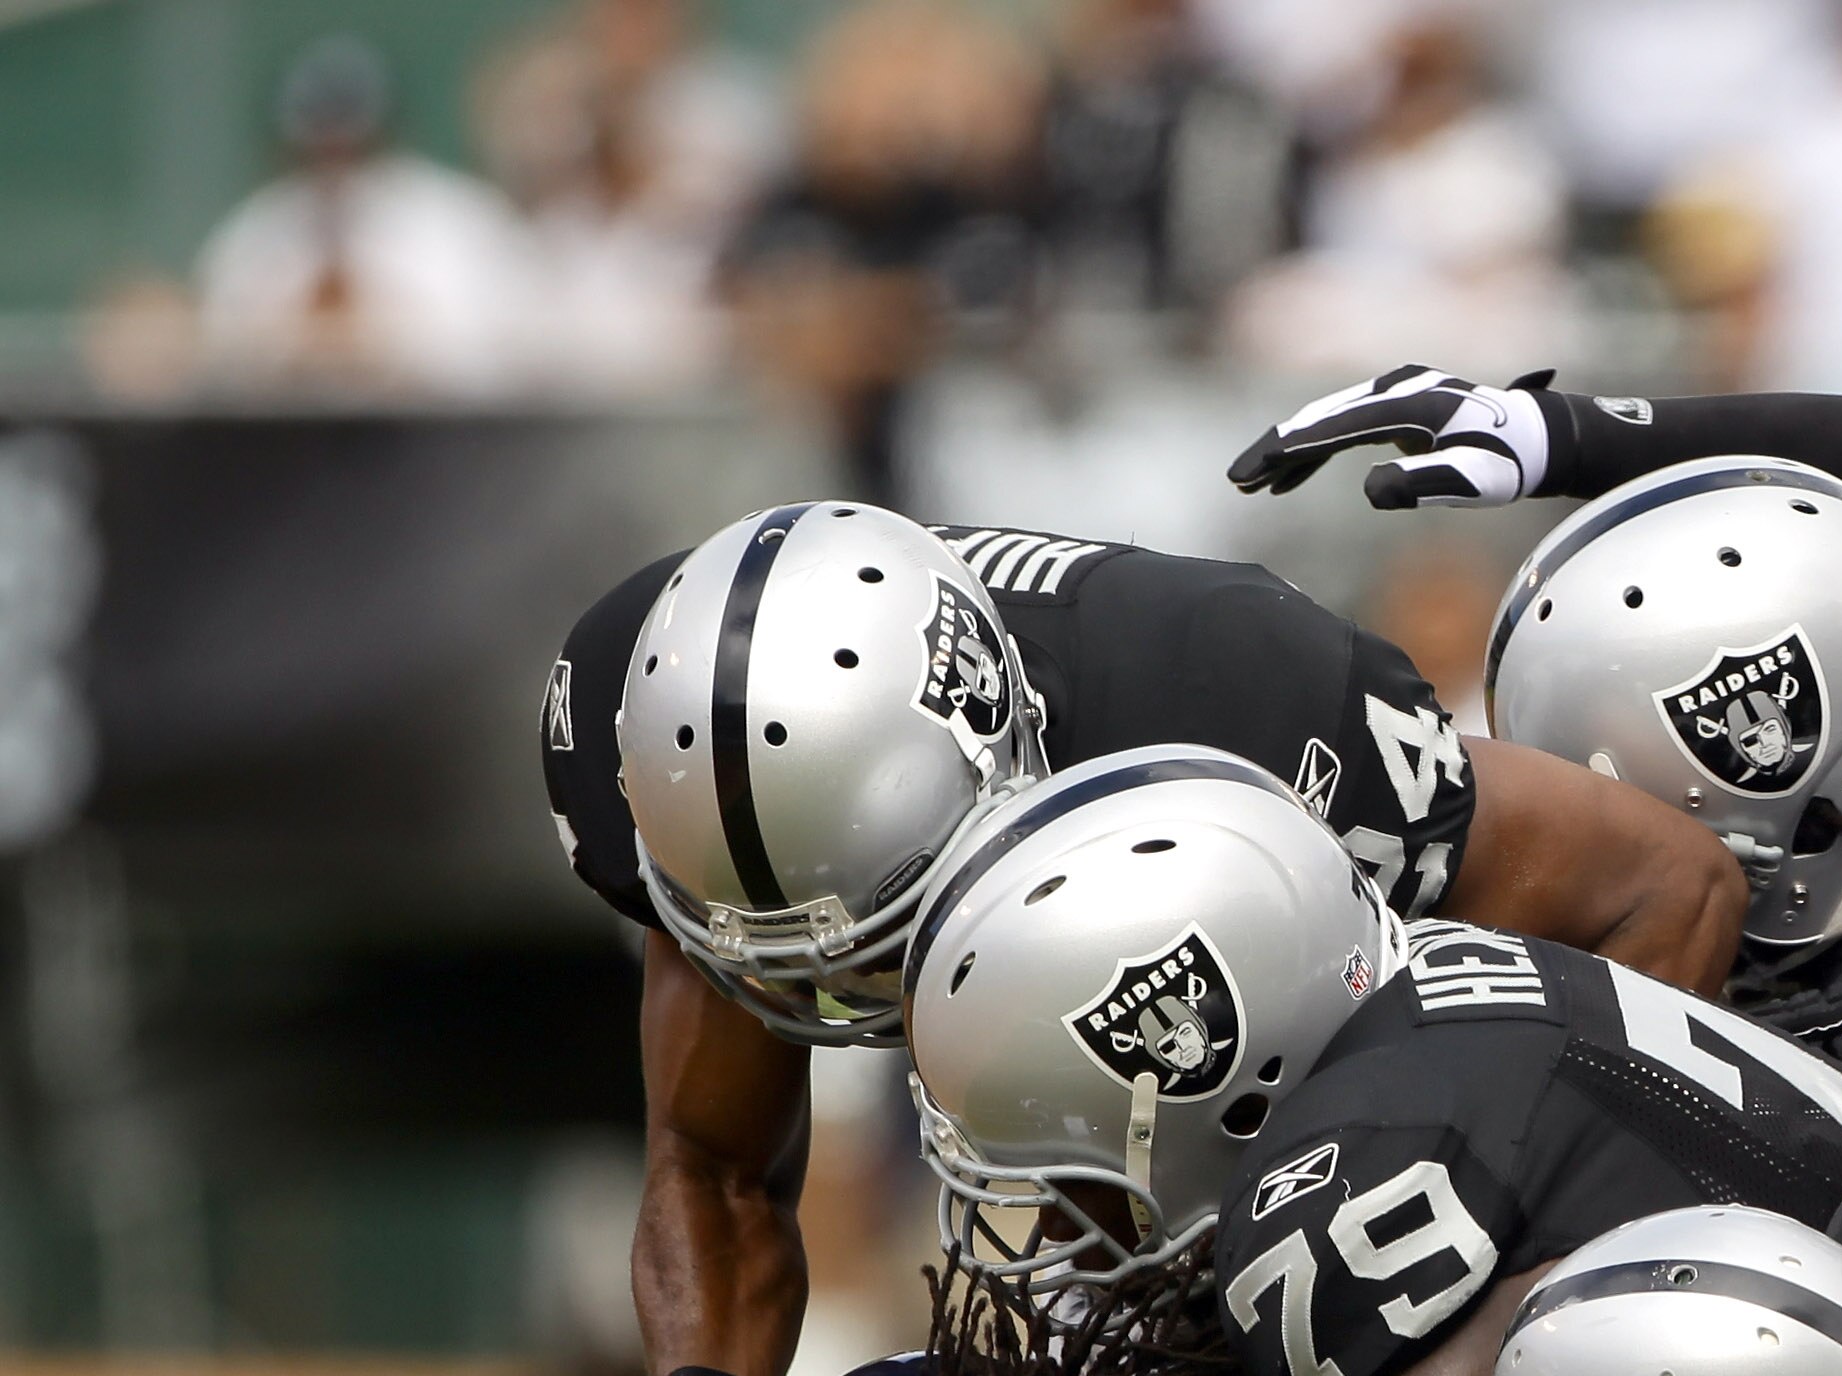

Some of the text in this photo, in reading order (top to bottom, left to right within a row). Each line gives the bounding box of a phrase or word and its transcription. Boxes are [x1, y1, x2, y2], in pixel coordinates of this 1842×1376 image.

[927, 588, 956, 699] RAIDERS
[1677, 645, 1794, 714] RAIDERS
[1087, 945, 1195, 1032] RAIDERS
[1350, 963, 1374, 994] NFL
